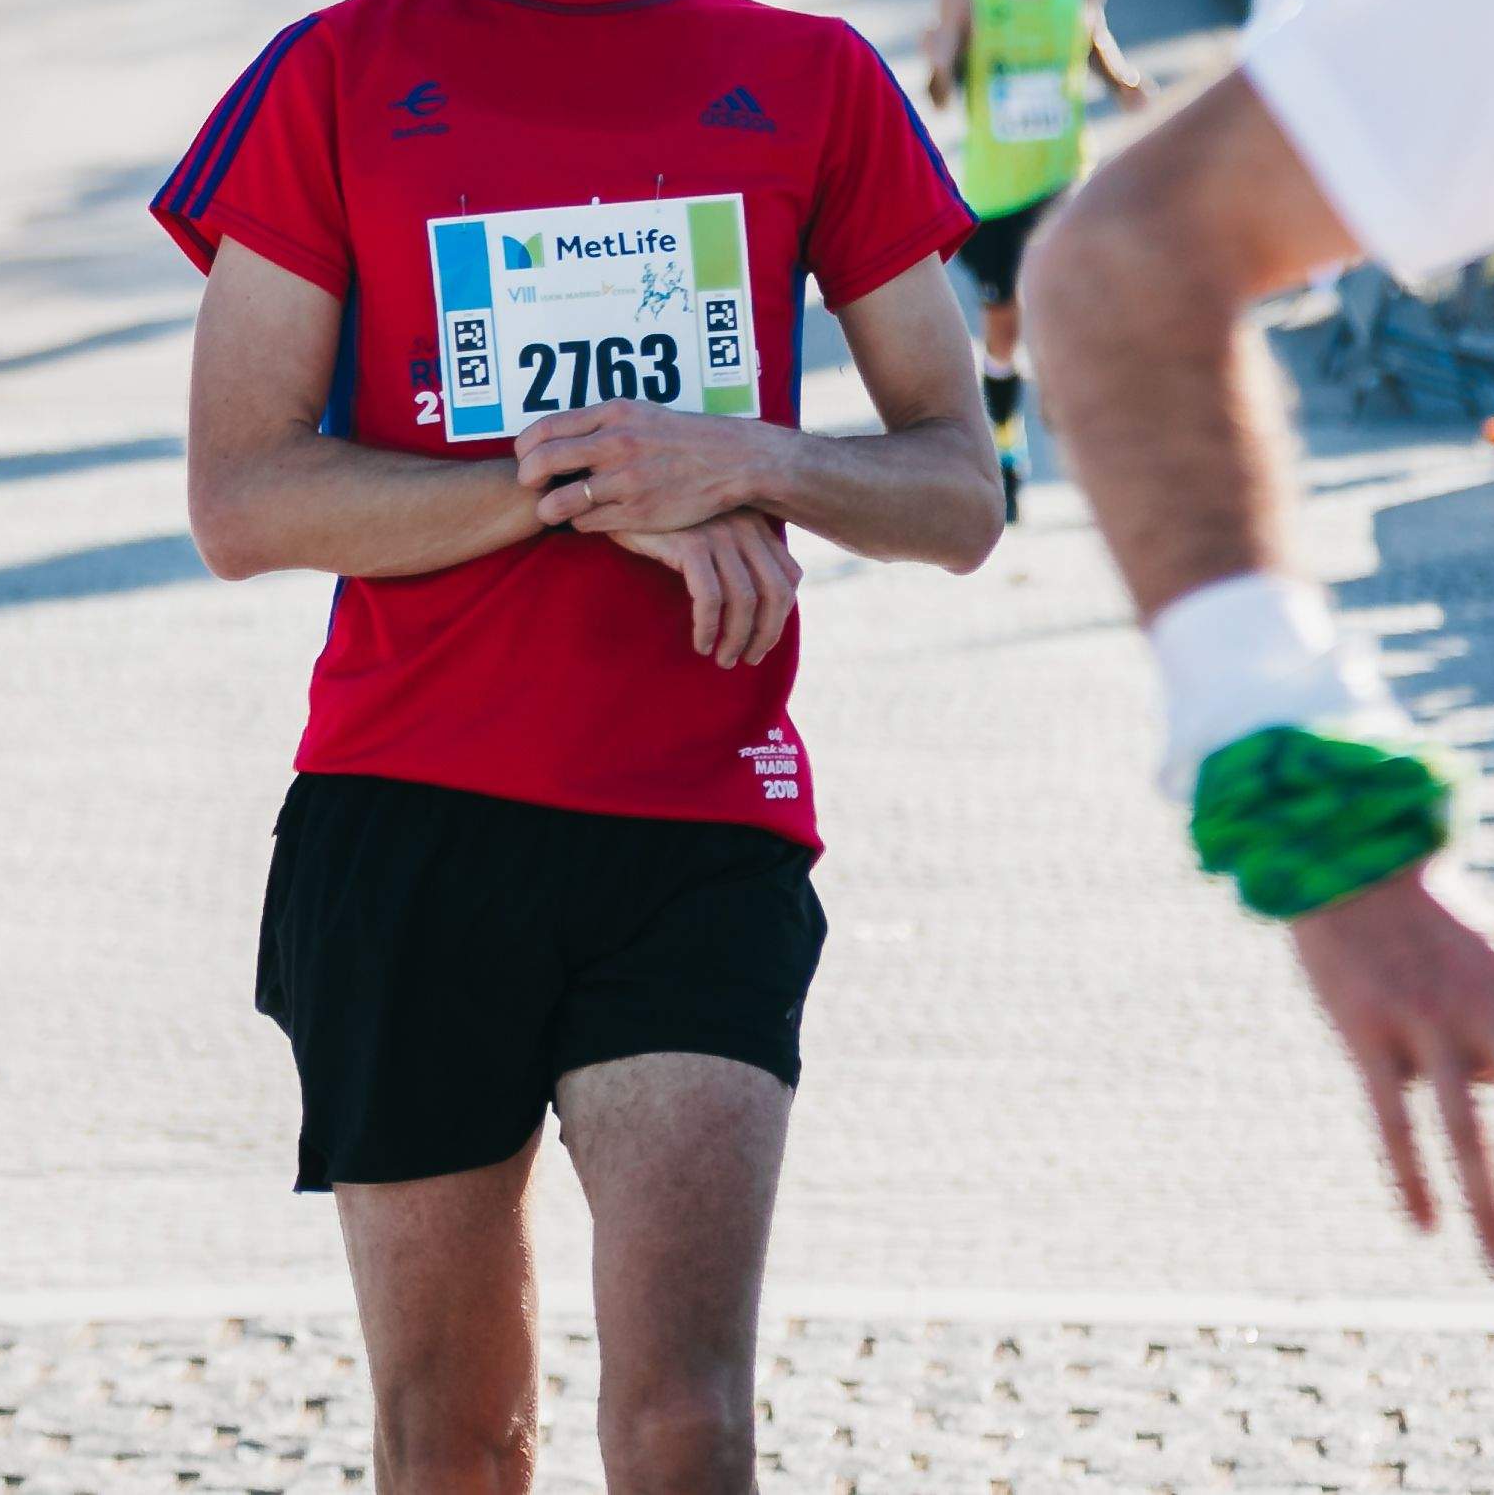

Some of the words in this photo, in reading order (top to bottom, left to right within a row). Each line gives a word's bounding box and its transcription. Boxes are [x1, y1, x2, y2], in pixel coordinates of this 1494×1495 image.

[556, 228, 677, 262] MetLife
[507, 286, 536, 303] VIII
[519, 333, 681, 413] 2763
[755, 760, 797, 775] MADRID
[763, 780, 799, 799] 2018
